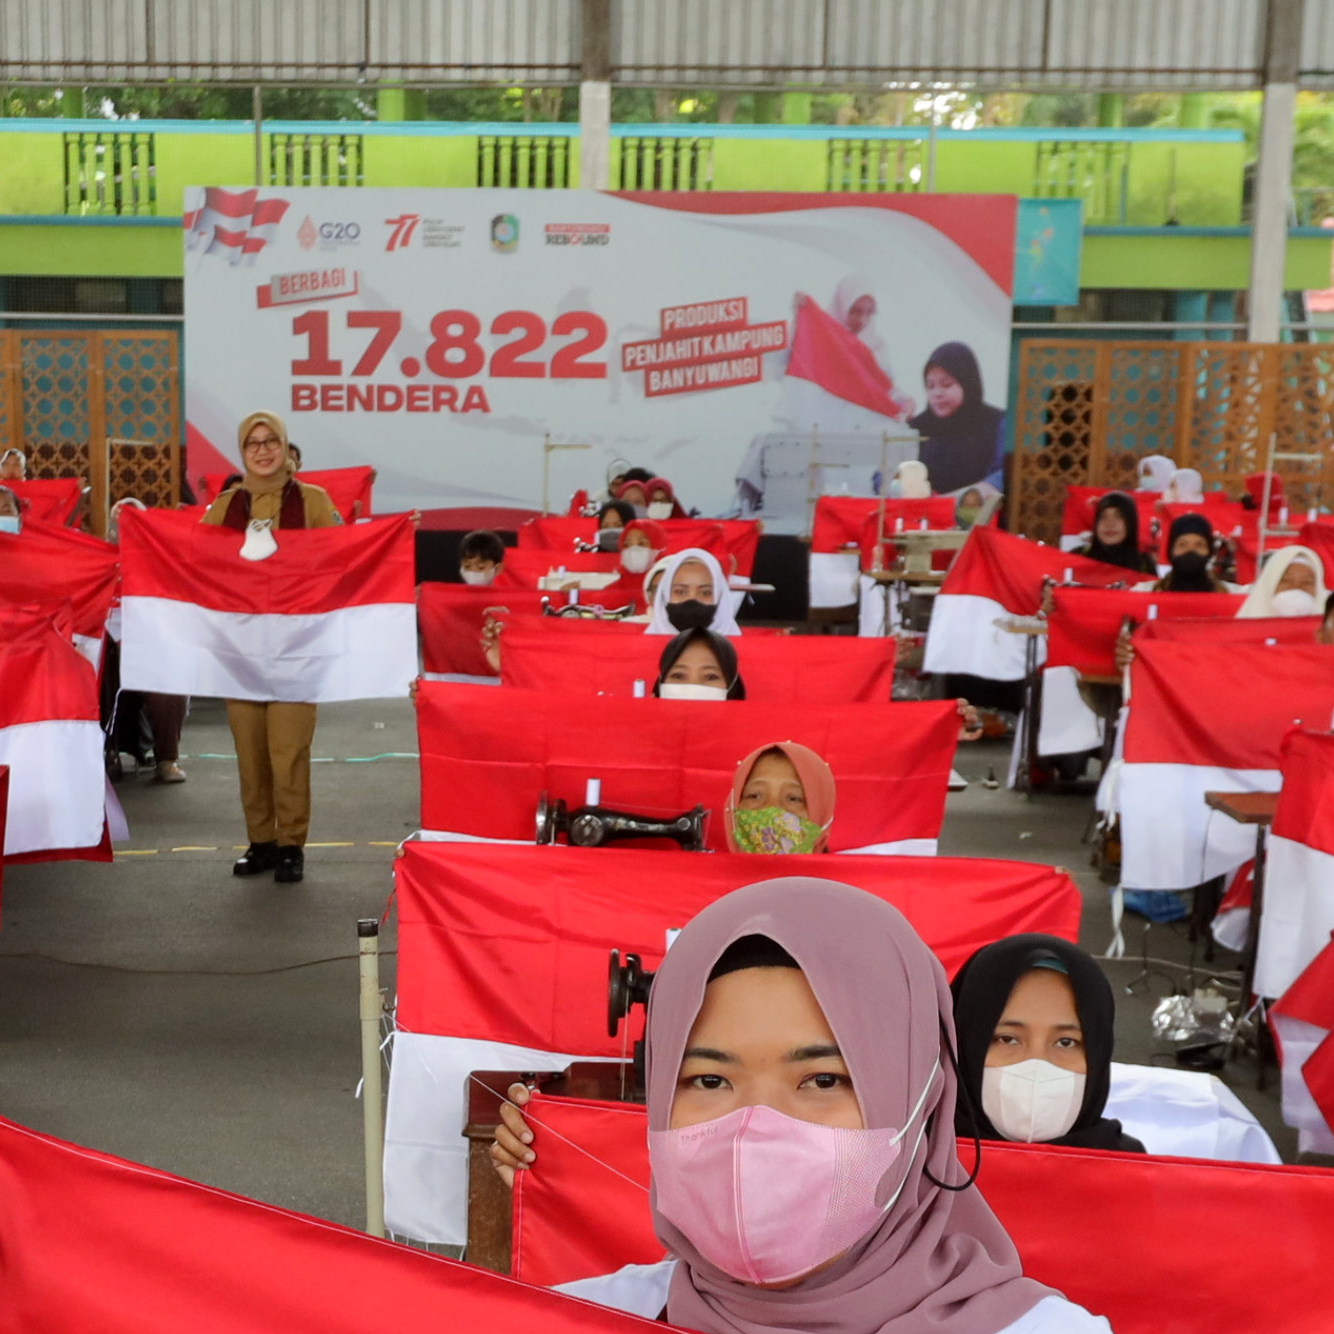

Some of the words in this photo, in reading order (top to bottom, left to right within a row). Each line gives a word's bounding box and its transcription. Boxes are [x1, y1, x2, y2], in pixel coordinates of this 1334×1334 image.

[318, 222, 361, 240] G20
[385, 214, 420, 252] 77
[279, 267, 346, 296] BERBAGI
[664, 300, 744, 330] PRODUKSI
[291, 310, 608, 379] 17.822
[624, 336, 701, 367] PENJAHIT
[703, 325, 785, 357] KAMPUNG
[649, 356, 759, 392] BANYUWANGI
[291, 383, 491, 413] BENDERA
